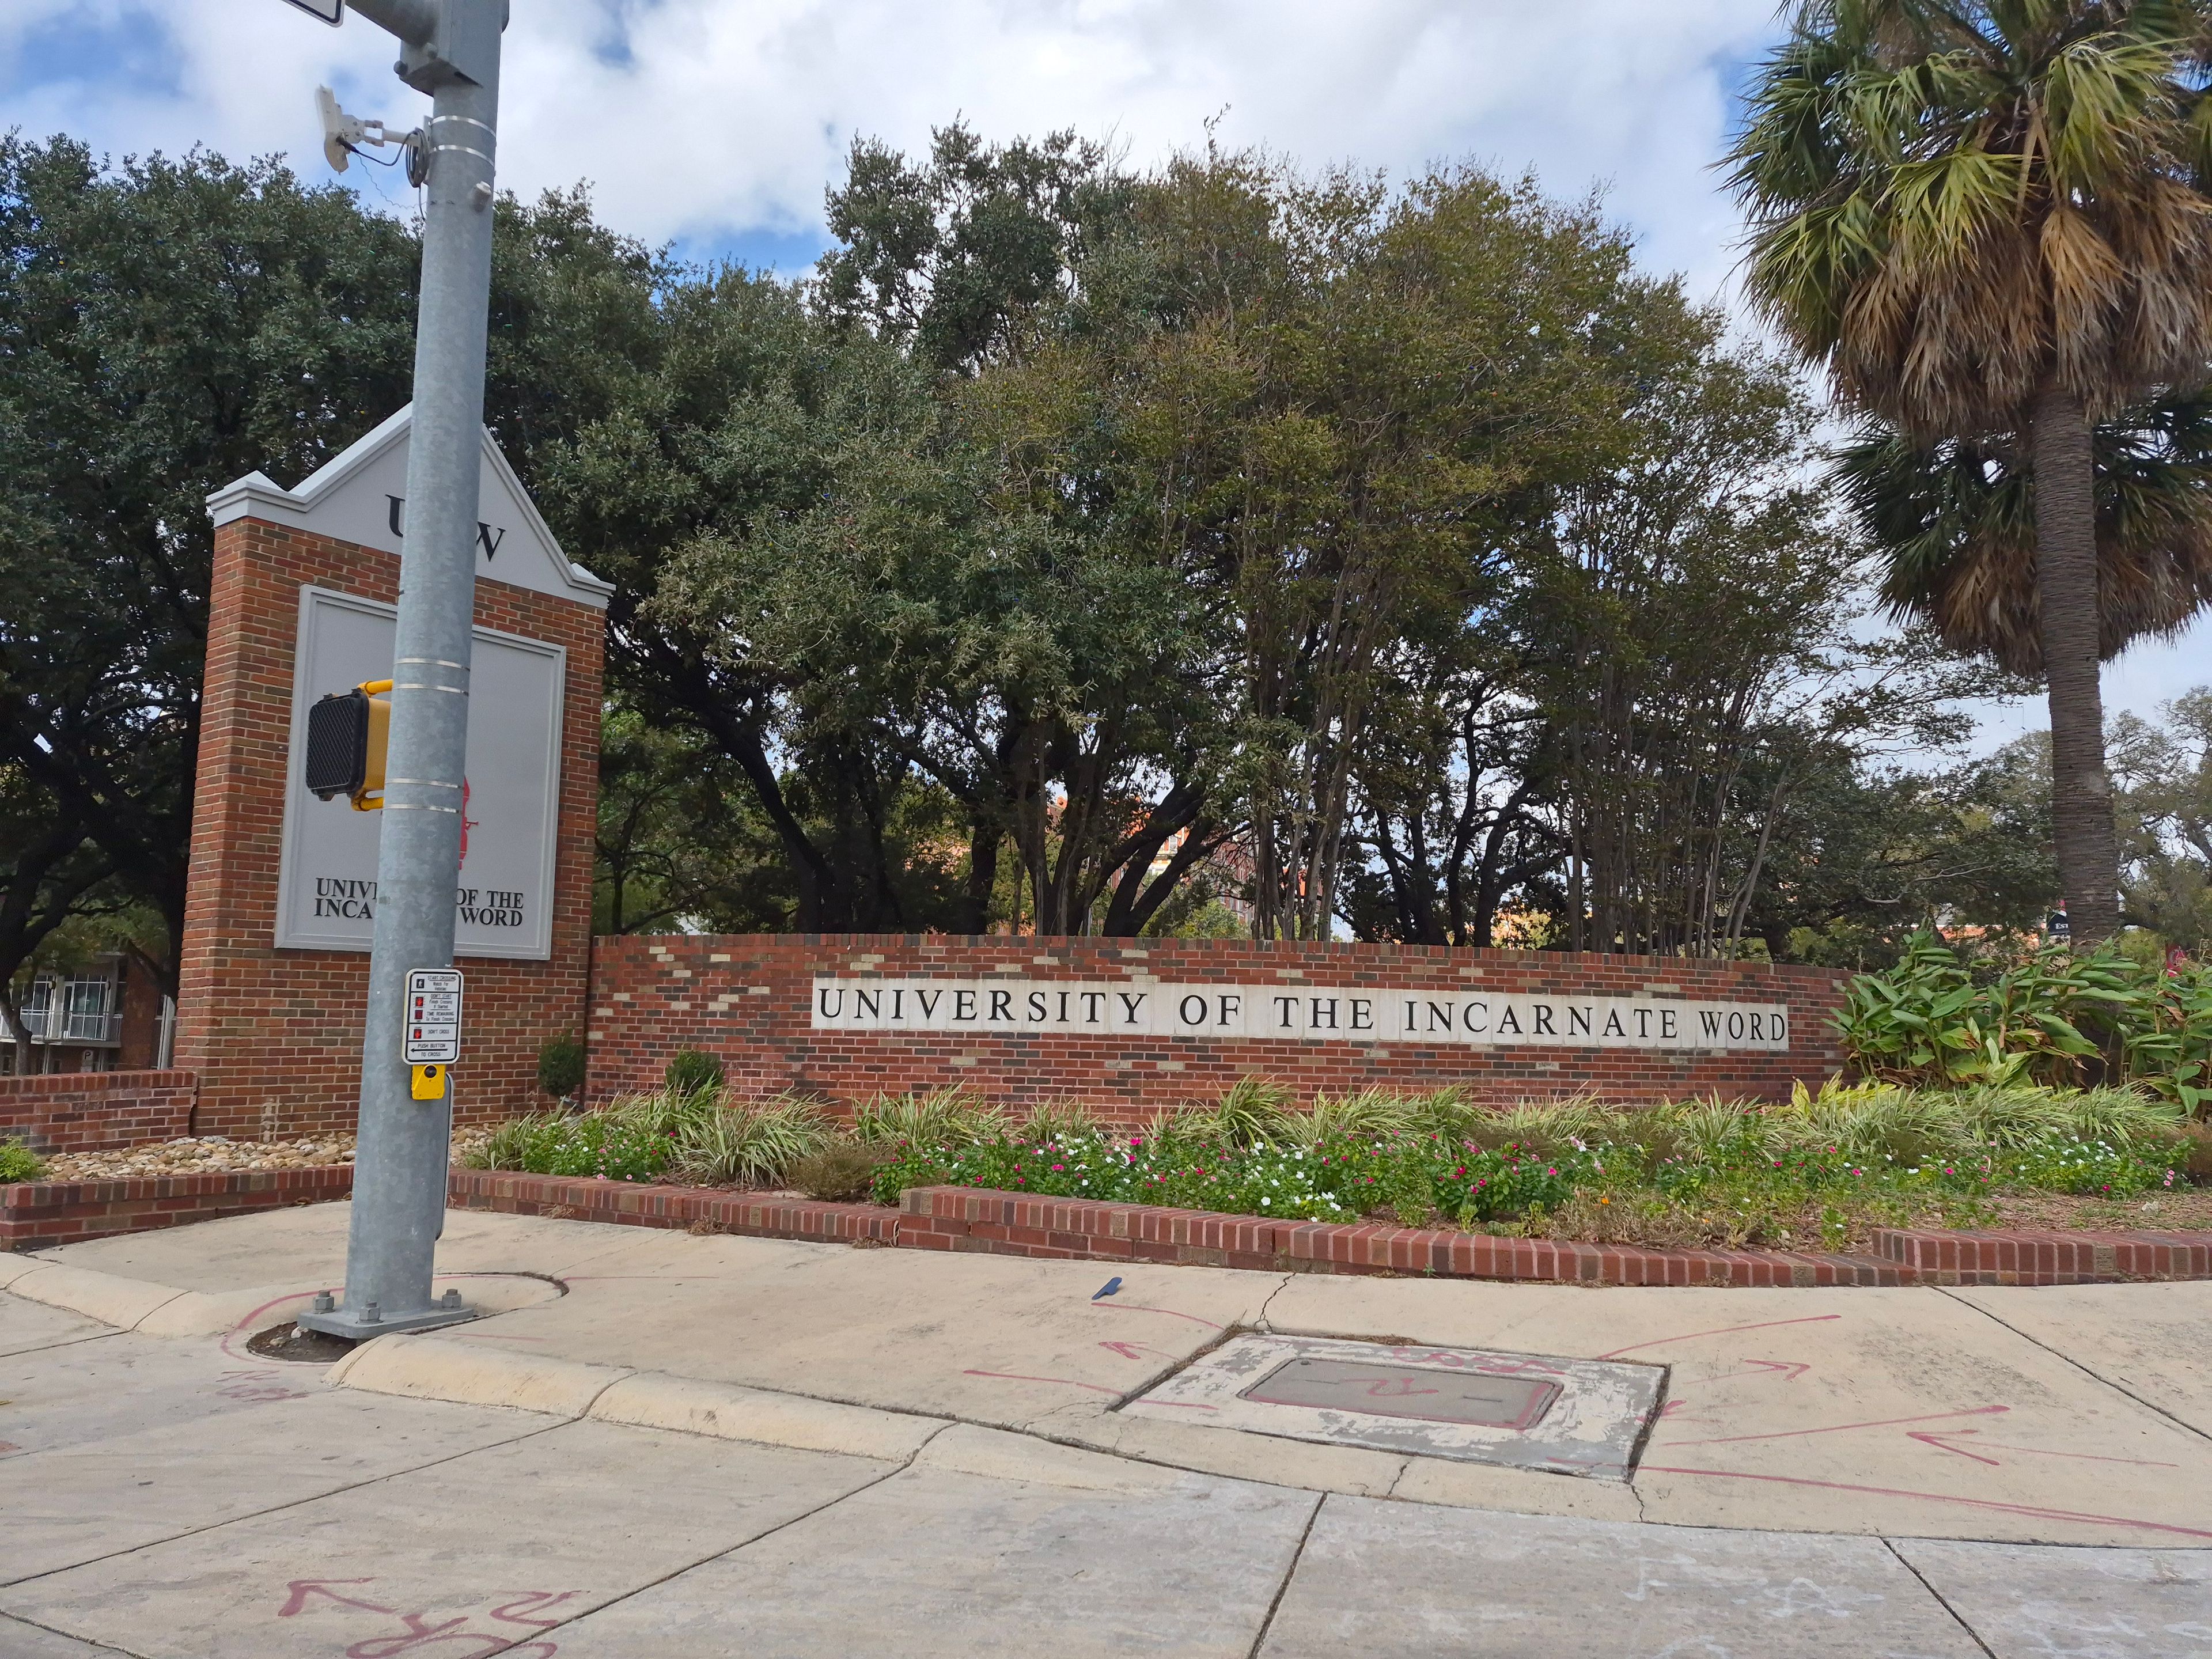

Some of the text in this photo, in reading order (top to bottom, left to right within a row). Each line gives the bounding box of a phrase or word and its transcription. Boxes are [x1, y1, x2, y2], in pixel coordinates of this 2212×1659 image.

[384, 494, 506, 563] UW
[460, 907, 523, 926] WORD
[486, 891, 524, 909] THE
[818, 988, 1785, 1041] UNIVERSITY OF THE INCARNATE WORD
